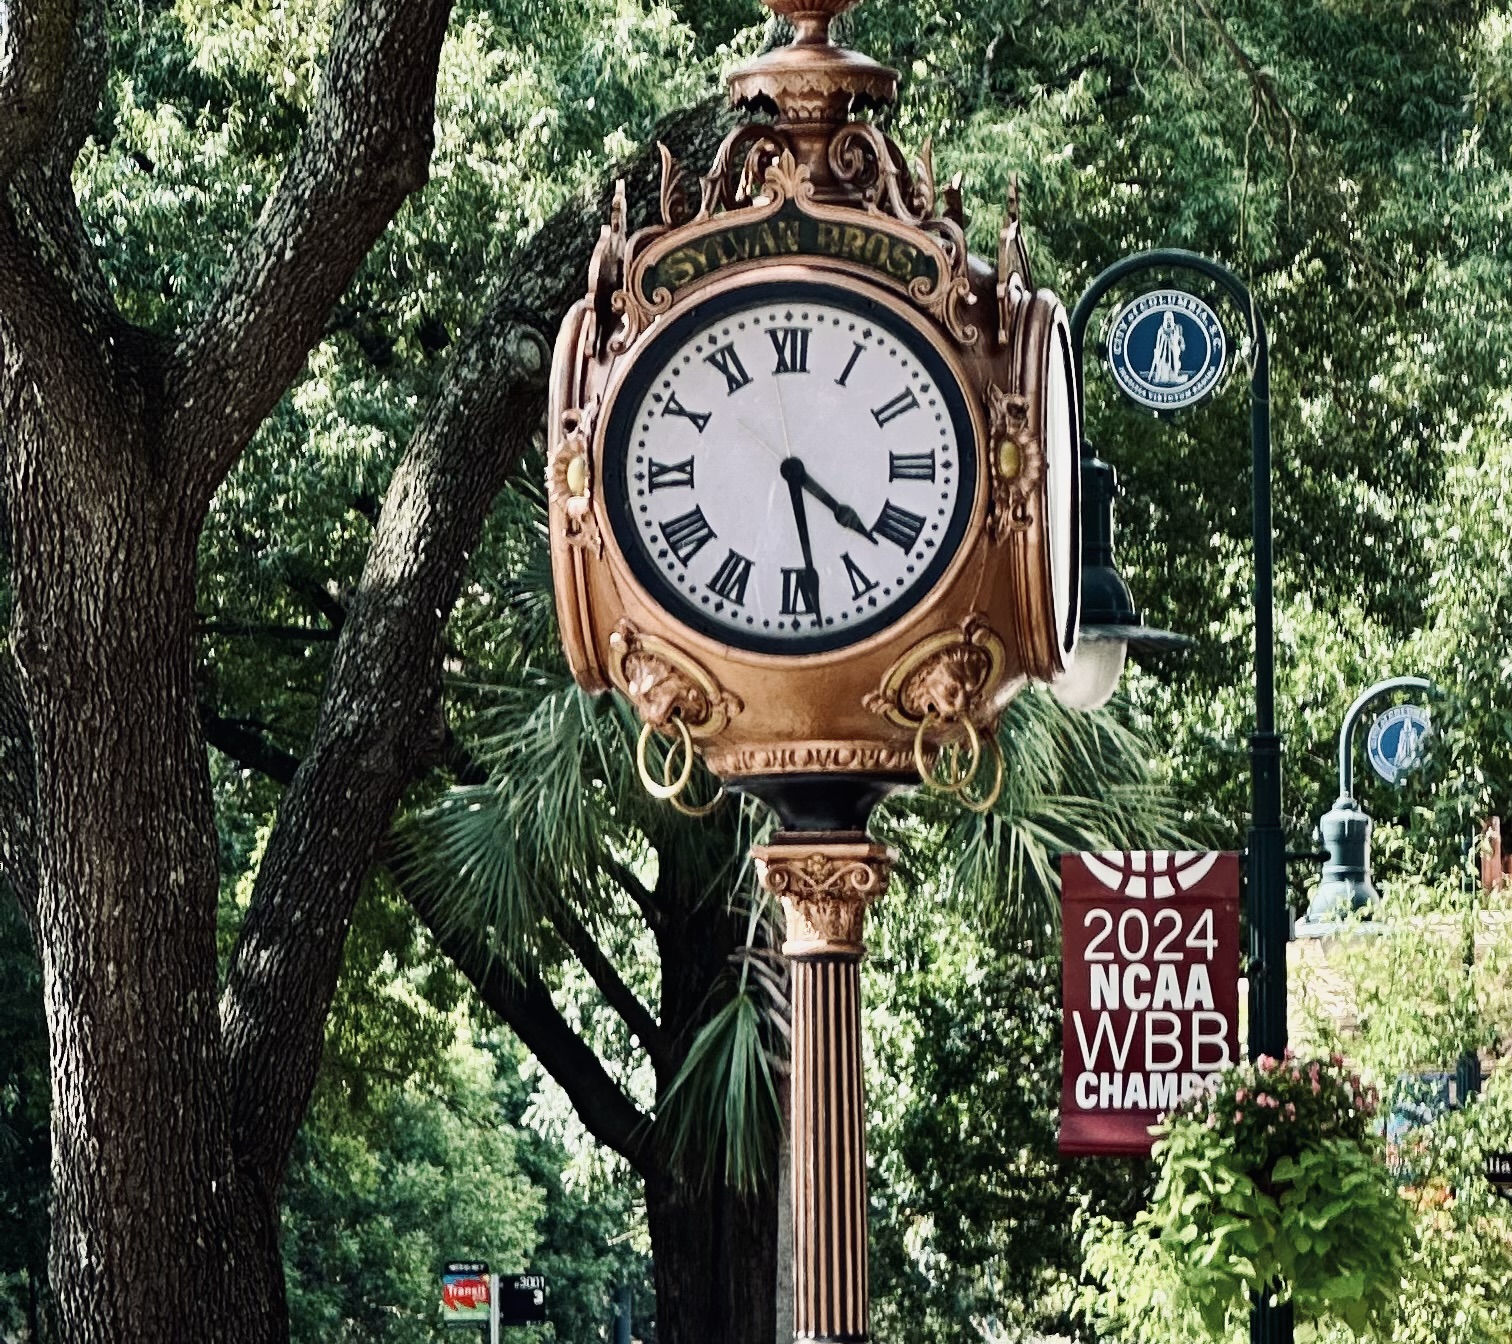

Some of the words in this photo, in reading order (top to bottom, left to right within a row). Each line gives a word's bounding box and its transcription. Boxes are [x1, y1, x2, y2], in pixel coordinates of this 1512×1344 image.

[665, 221, 799, 284] SYLVAN
[703, 342, 753, 396] XI
[765, 327, 812, 376] XII
[834, 341, 867, 387] I
[661, 391, 712, 433] X
[870, 385, 920, 428] II
[649, 455, 694, 494] IX
[888, 449, 935, 484] III
[659, 503, 717, 568] VIII
[870, 498, 927, 556] IIII
[706, 548, 755, 607] VII
[840, 552, 880, 601] V
[1084, 908, 1219, 961] 2024
[1090, 963, 1215, 1011] NCAA
[1072, 1010, 1230, 1072] WBB
[447, 1283, 486, 1302] Transit
